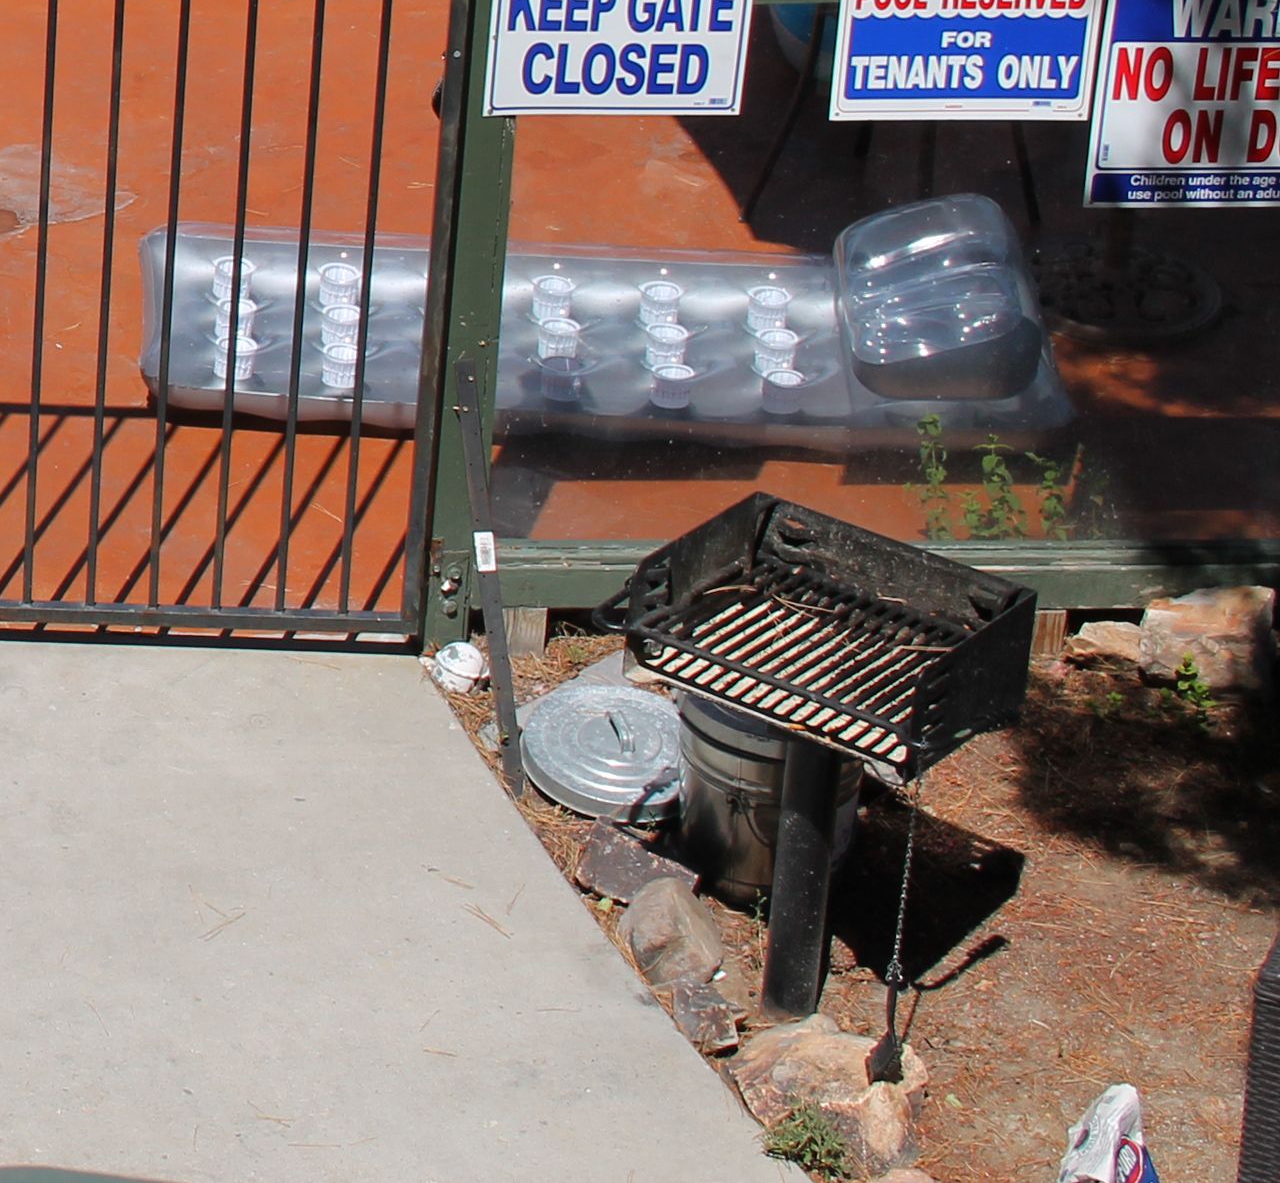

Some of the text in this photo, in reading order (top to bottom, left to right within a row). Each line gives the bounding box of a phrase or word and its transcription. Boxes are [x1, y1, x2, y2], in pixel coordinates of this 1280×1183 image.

[941, 32, 992, 48] FOR
[522, 42, 710, 96] CLOSED
[851, 55, 1079, 90] TENANTS ONLY
[1112, 46, 1174, 102] NO
[1162, 108, 1224, 165] ON
[1128, 190, 1253, 202] use pool without an
[1130, 174, 1276, 189] Children under the age
